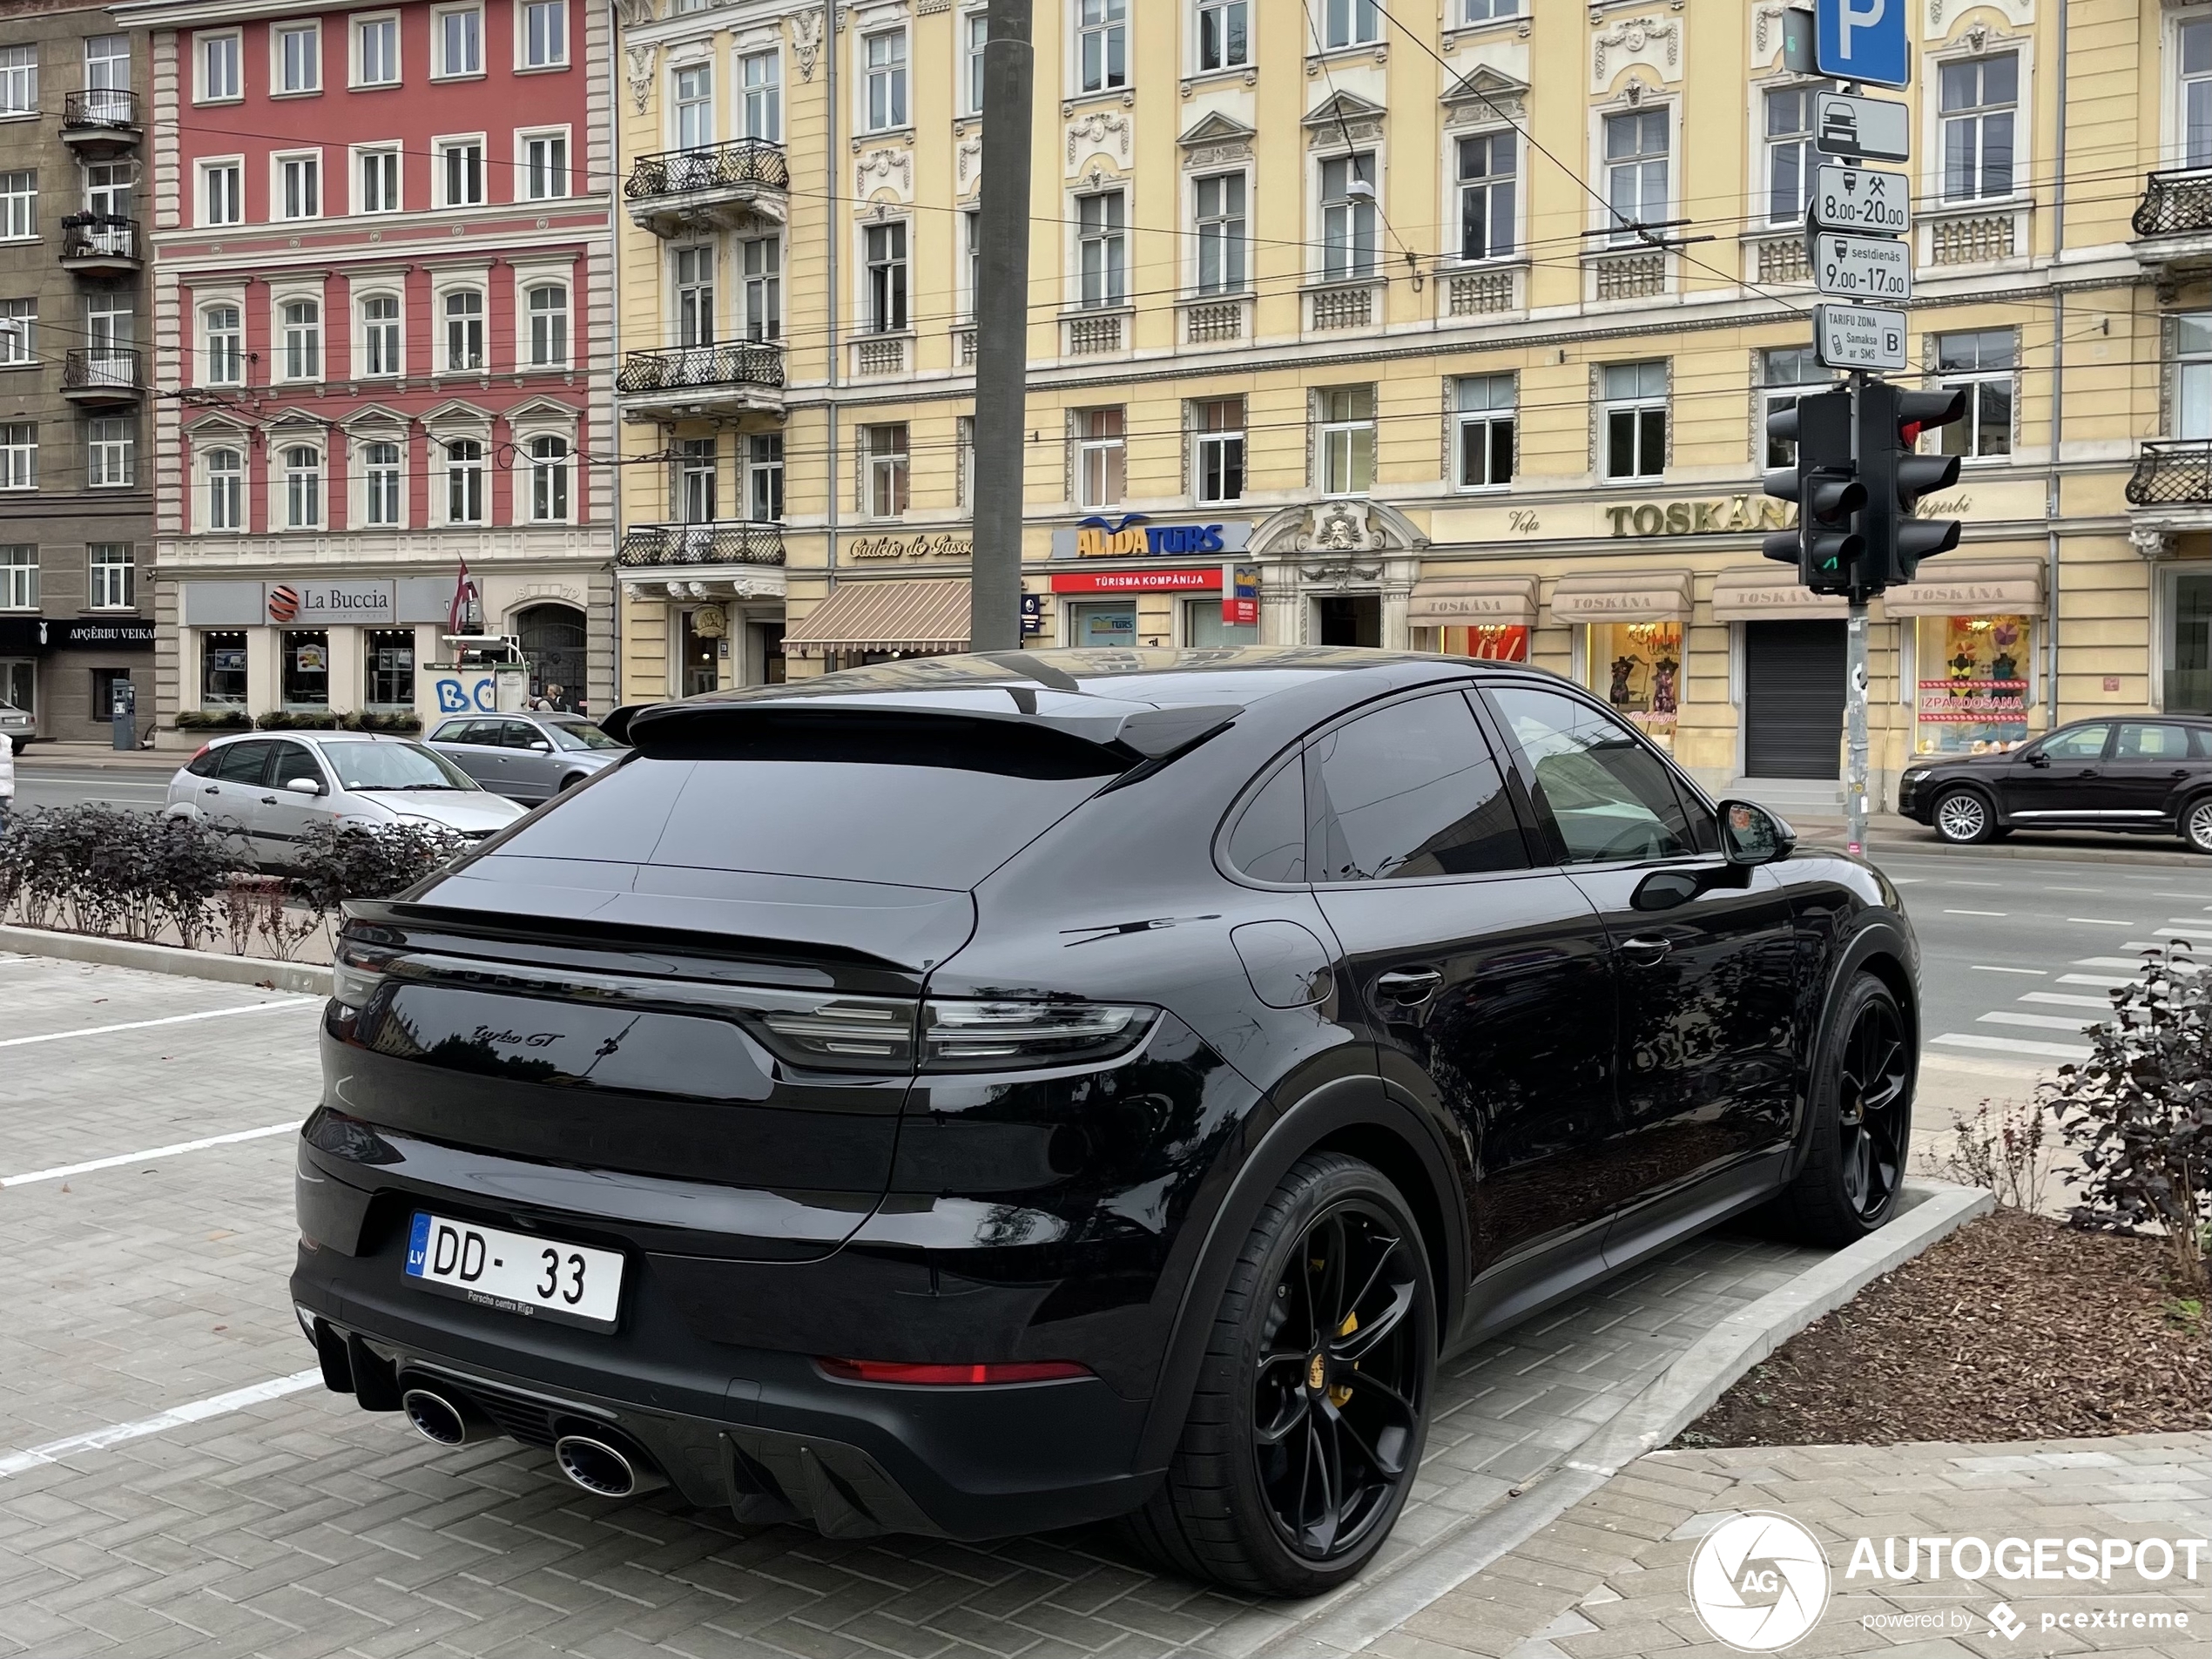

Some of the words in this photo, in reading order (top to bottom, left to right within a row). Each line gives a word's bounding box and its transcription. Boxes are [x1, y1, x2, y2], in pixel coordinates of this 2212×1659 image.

[1839, 0, 1885, 59] P
[1851, 248, 1901, 262] sestdienās
[1829, 313, 1856, 327] TARIFU
[1857, 316, 1878, 328] ZONA
[1846, 333, 1878, 345] Samaksa
[1886, 333, 1898, 352] B
[1860, 349, 1876, 360] SMS
[1605, 494, 1798, 537] TOSKĀN
[850, 536, 902, 558] Cadets
[906, 535, 929, 556] de
[1095, 577, 1140, 586] TŪRISMA
[1143, 574, 1204, 586] KOMPĀNIJA
[304, 590, 325, 609] La
[329, 589, 388, 609] Buccia
[70, 626, 118, 640] APĢĒRBU
[525, 1033, 566, 1047] GT
[410, 1250, 425, 1265] LV
[536, 1248, 586, 1305] 33
[468, 1290, 495, 1306] Porsche
